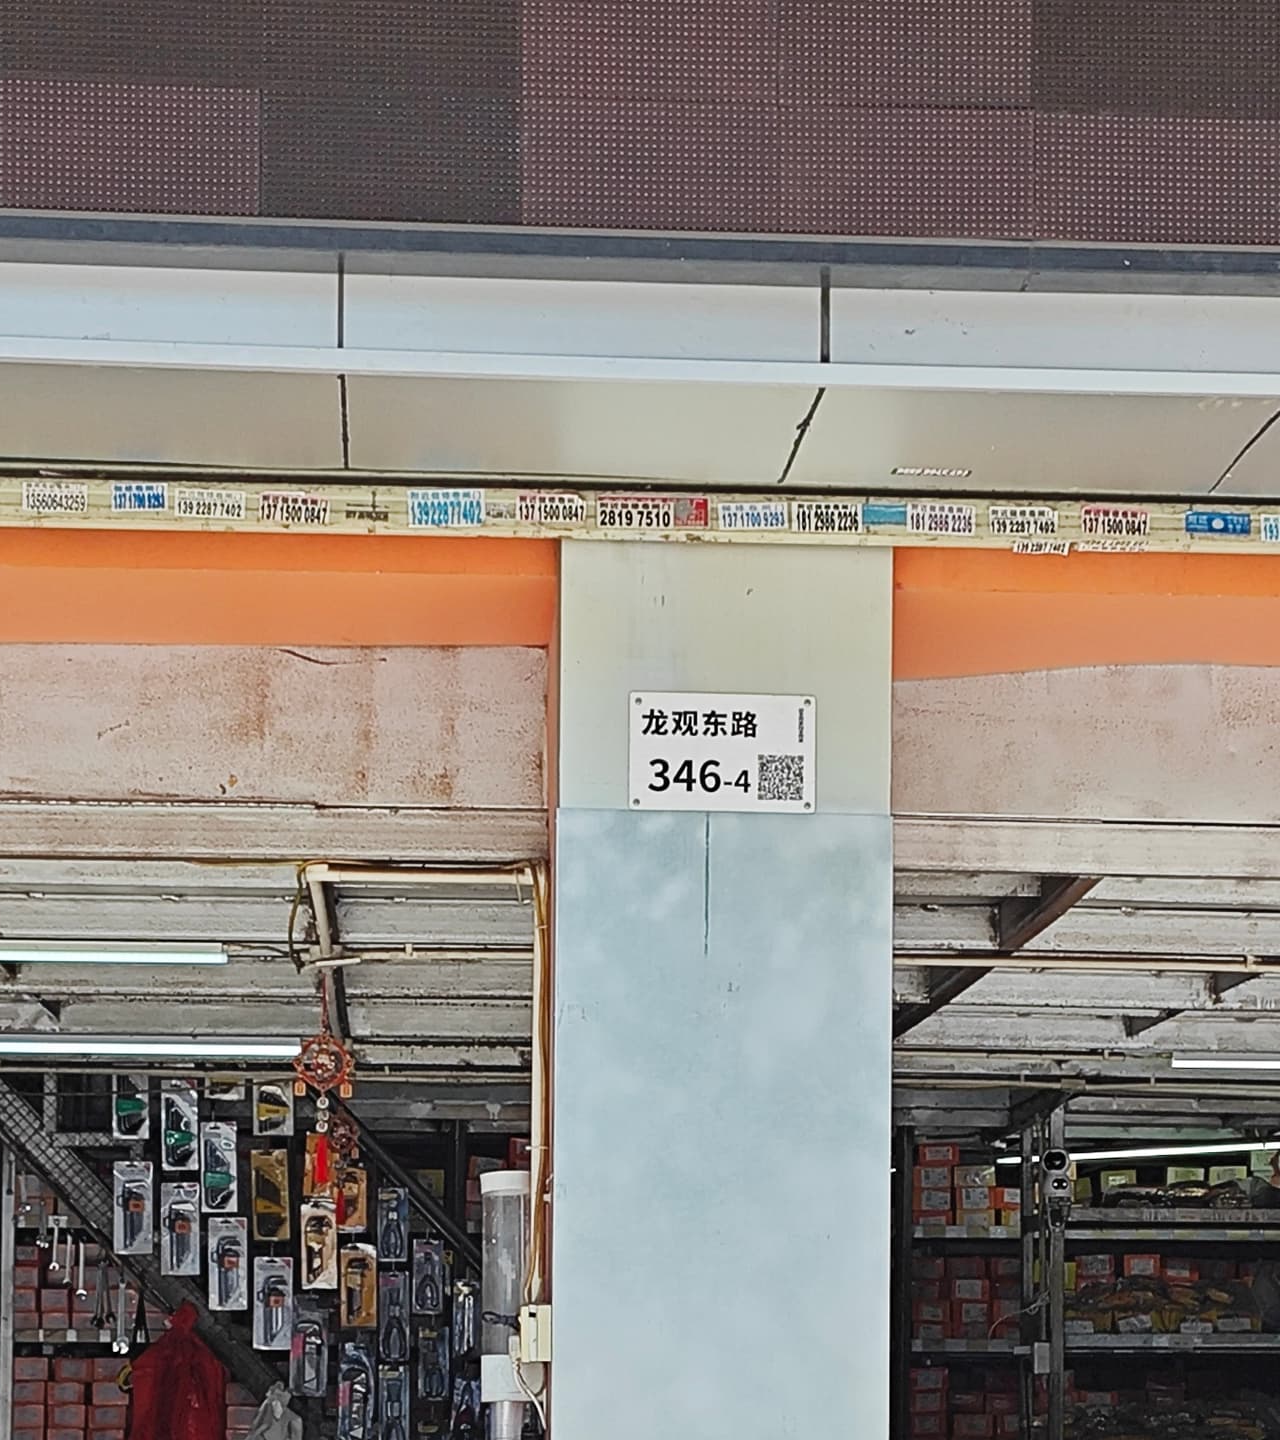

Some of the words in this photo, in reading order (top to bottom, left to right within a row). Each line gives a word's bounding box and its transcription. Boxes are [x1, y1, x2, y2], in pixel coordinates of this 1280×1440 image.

[178, 501, 193, 514] 139
[196, 502, 217, 516] 2287
[220, 503, 242, 517] 7402
[261, 505, 277, 520] 137
[280, 505, 302, 522] 1500
[304, 506, 327, 523] 0847
[519, 504, 535, 521] 137
[538, 504, 559, 521] 1500
[562, 504, 584, 521] 0847
[600, 510, 632, 527] 2819
[637, 511, 670, 527] 7510
[722, 513, 738, 527] 137
[740, 513, 761, 527] 1700
[763, 511, 784, 526] 9293
[1083, 518, 1098, 533] 137
[1102, 518, 1123, 535] 1500
[1125, 519, 1147, 536] 0847
[641, 708, 758, 738] 龙观东路
[647, 758, 751, 793] 346-4
